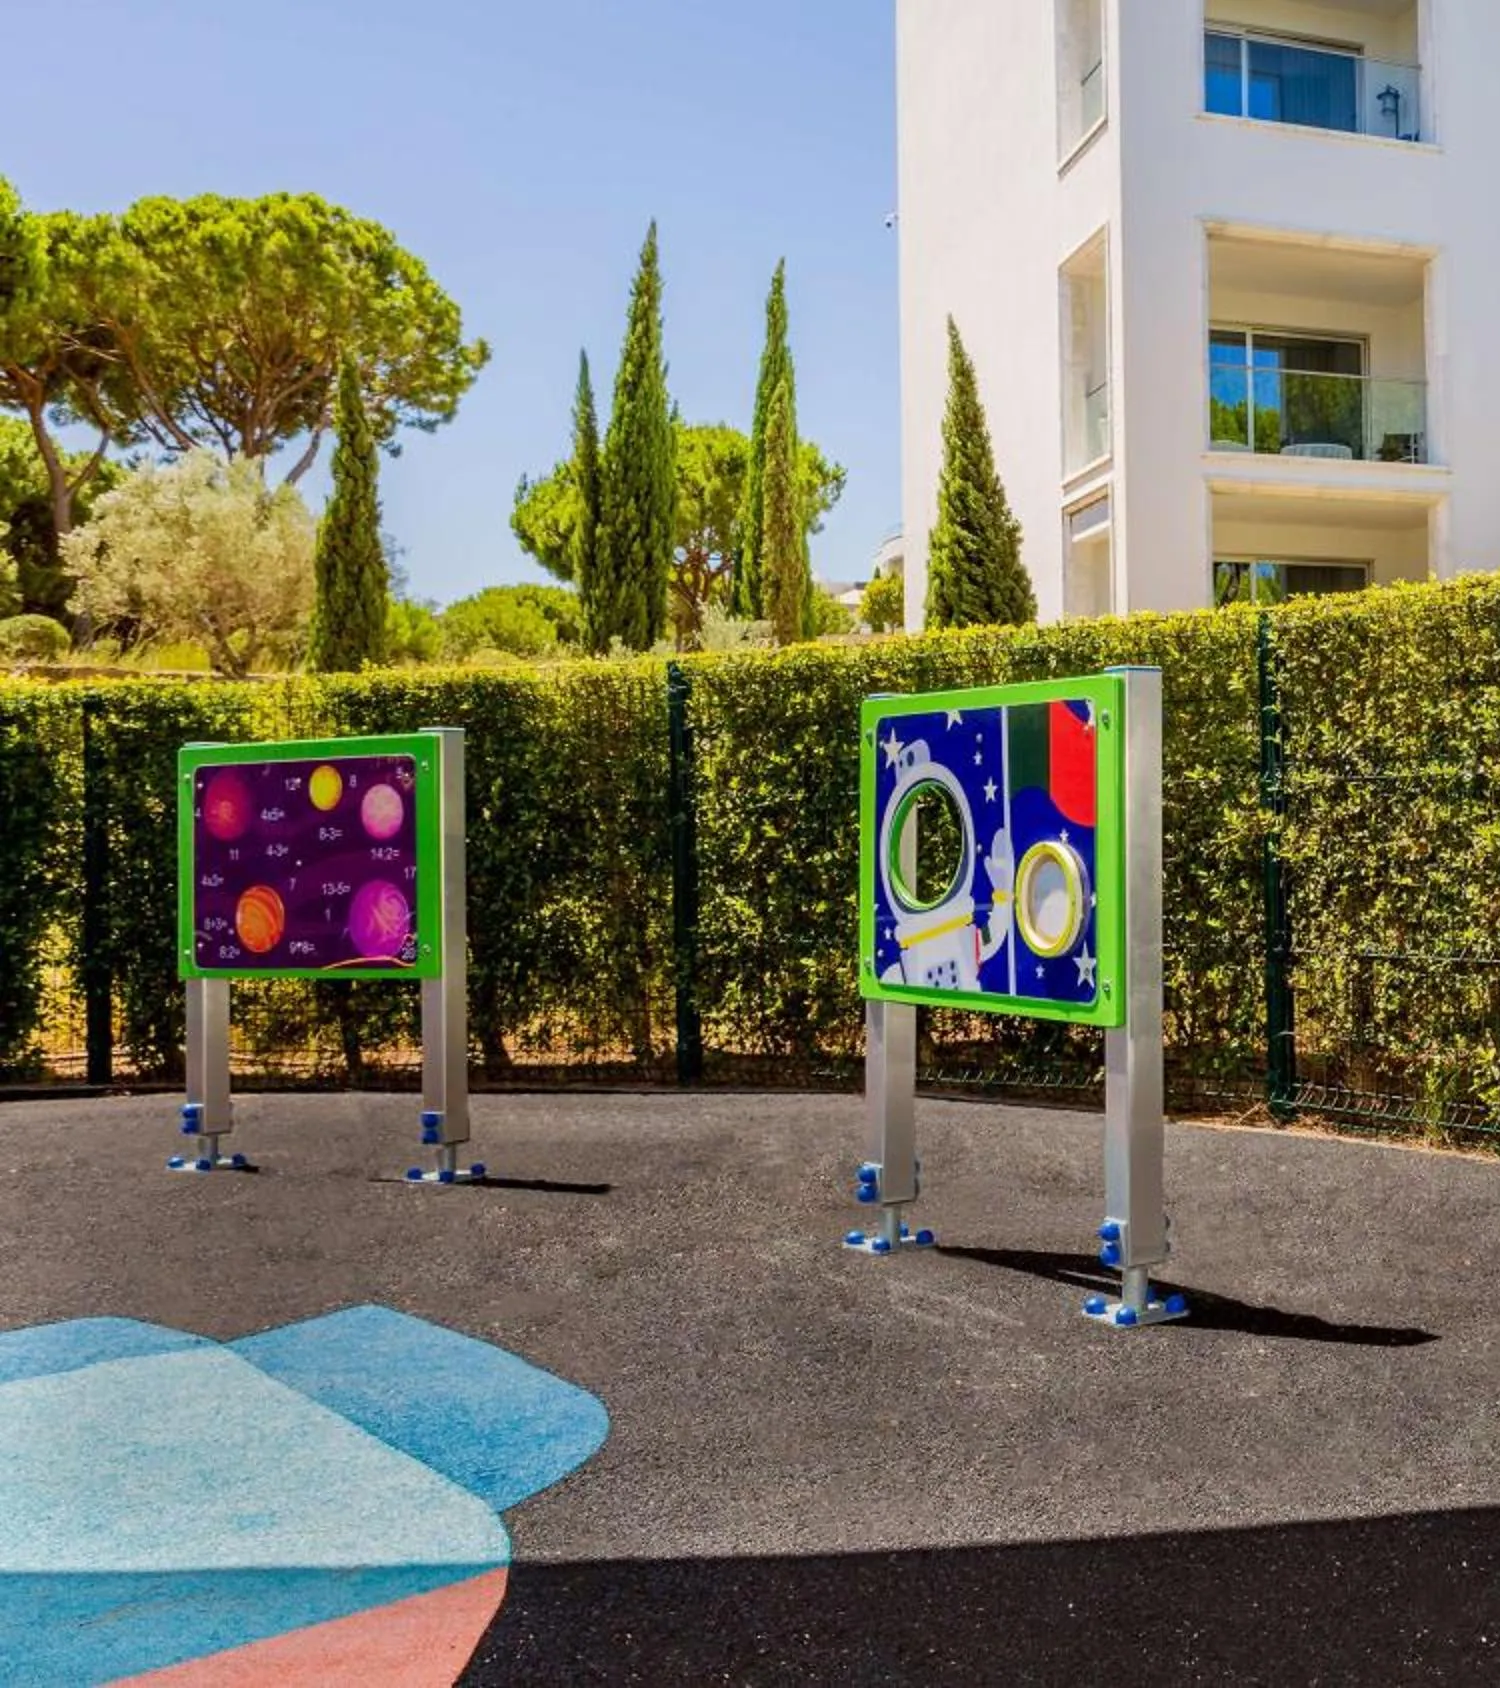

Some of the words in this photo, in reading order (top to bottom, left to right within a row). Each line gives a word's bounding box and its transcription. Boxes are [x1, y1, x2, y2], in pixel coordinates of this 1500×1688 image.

[229, 848, 240, 861] 11
[404, 866, 416, 880] 17
[290, 877, 297, 891] 7
[325, 908, 331, 922] 1
